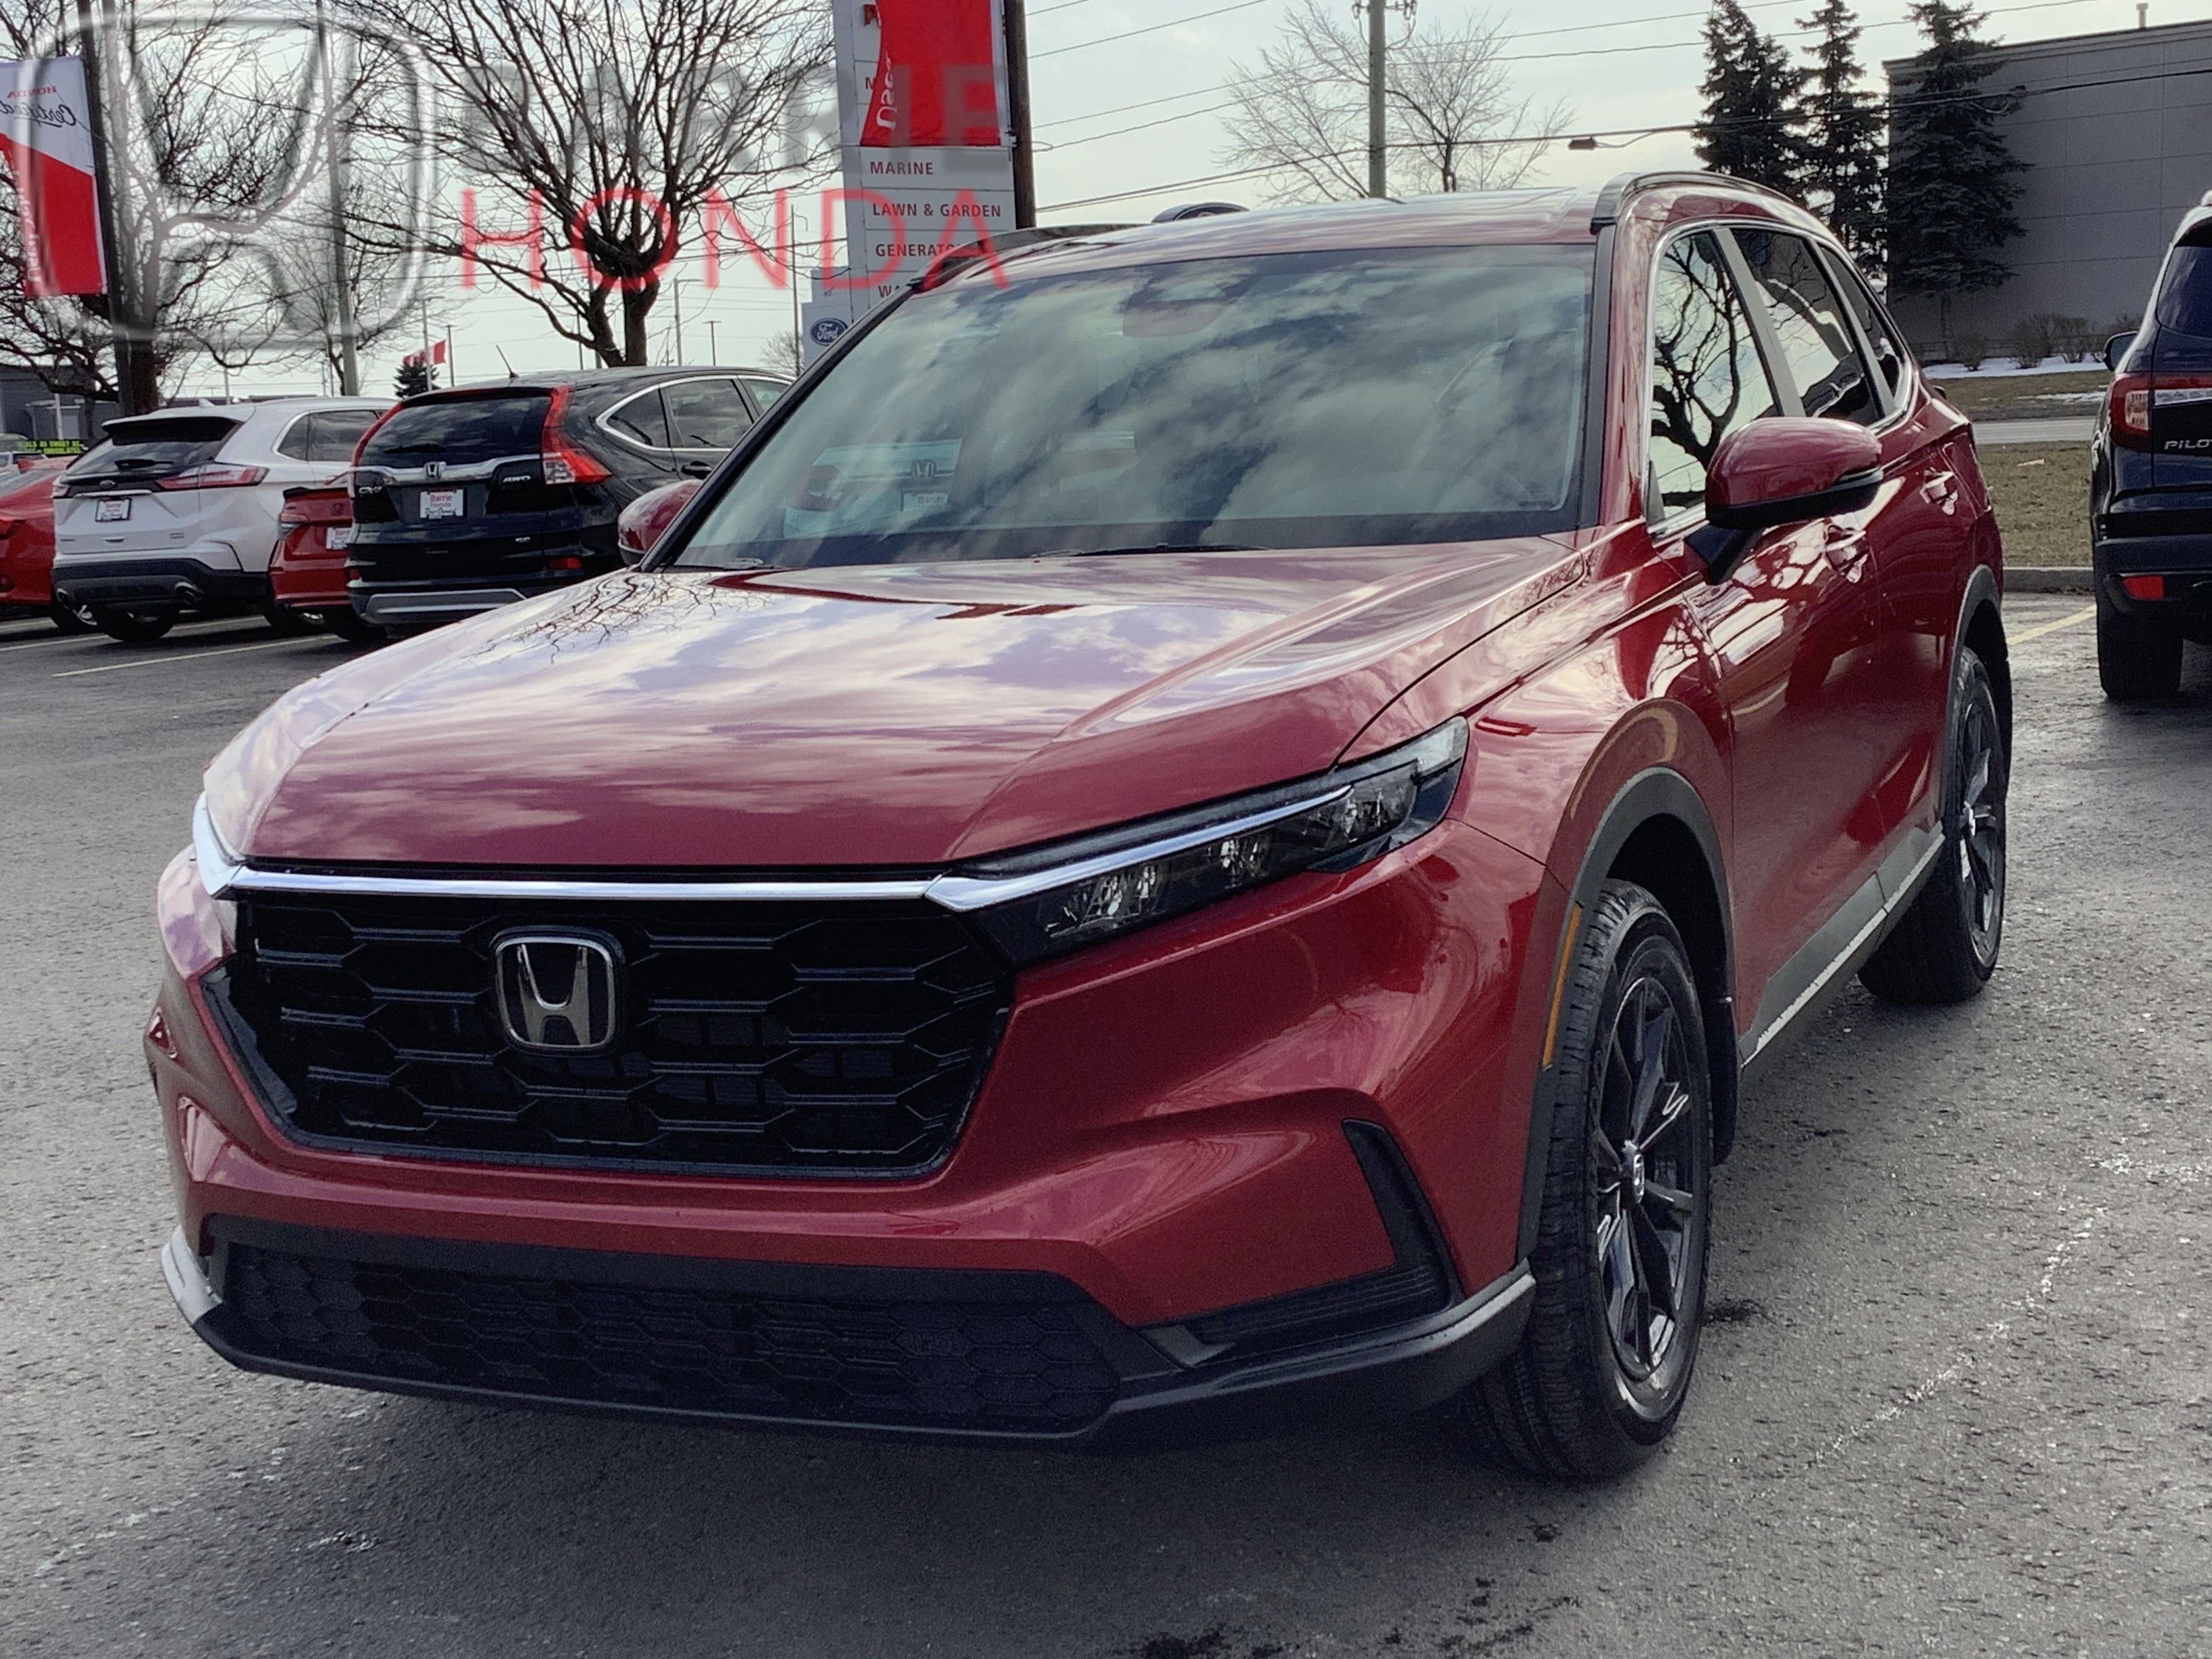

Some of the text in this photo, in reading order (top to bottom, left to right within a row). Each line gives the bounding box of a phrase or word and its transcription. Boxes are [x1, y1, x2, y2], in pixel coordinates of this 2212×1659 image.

[869, 161, 934, 176] MARINE
[872, 203, 1002, 218] LAWN & GARDEN
[2164, 438, 2212, 450] PILO
